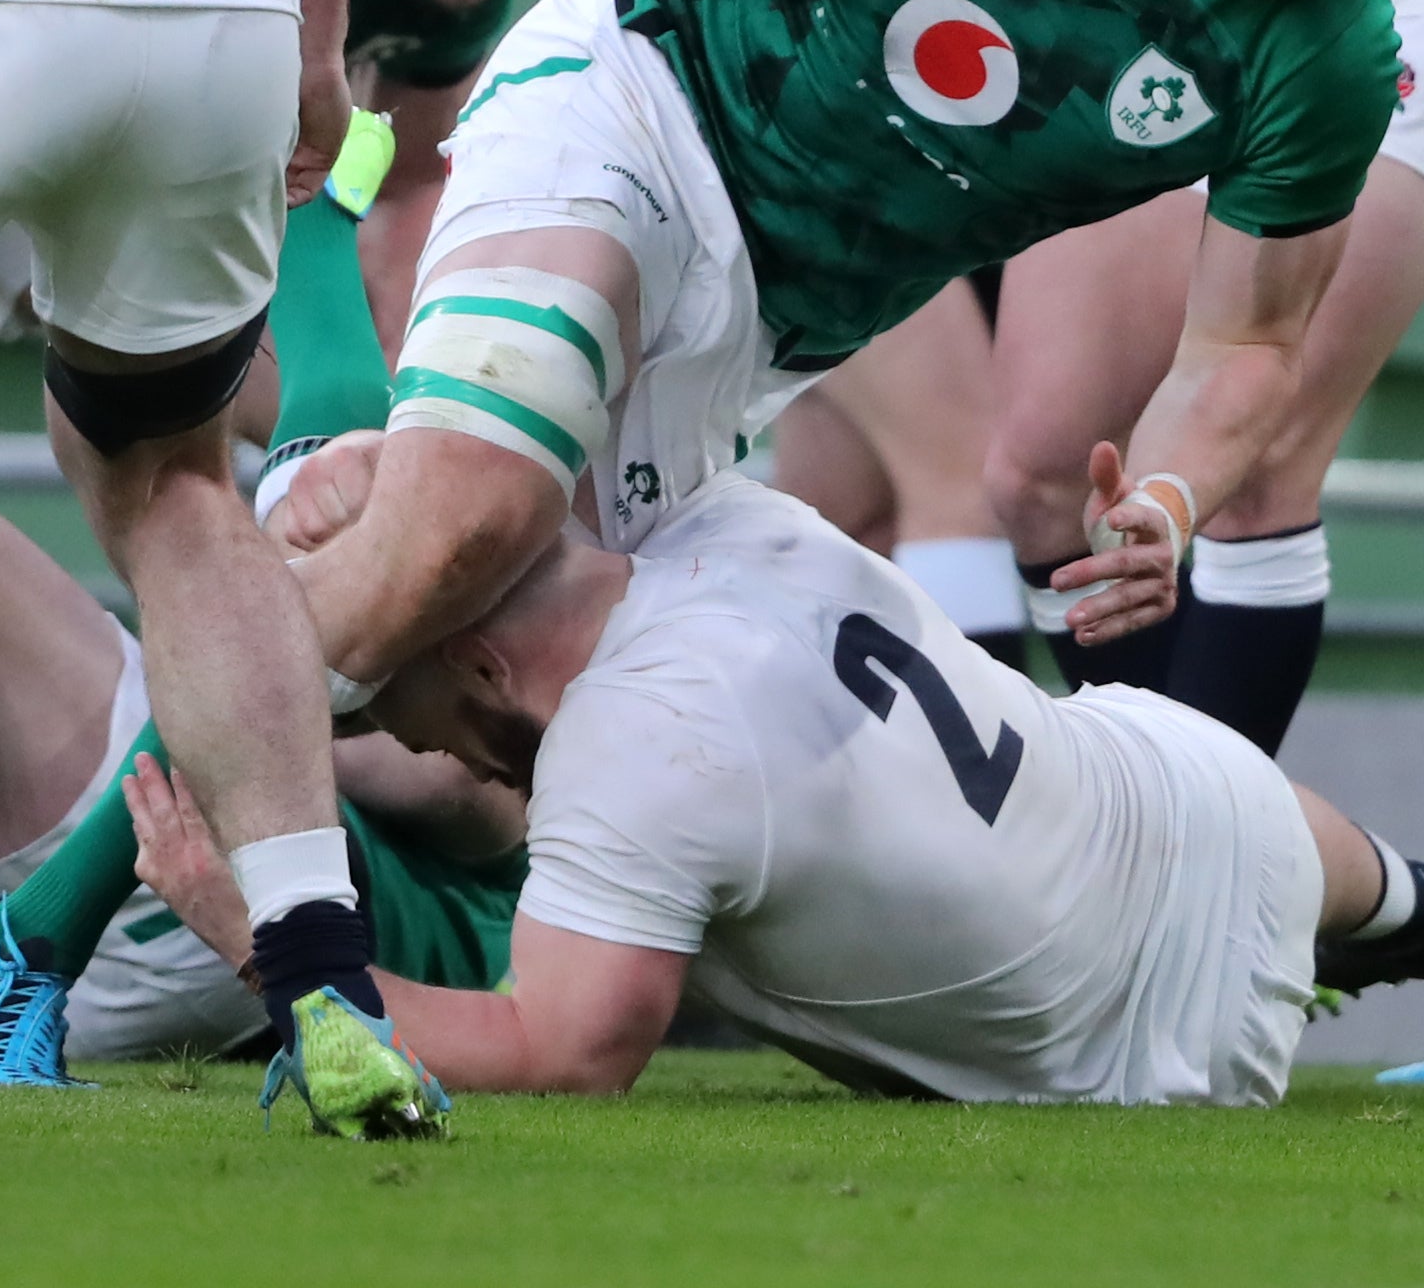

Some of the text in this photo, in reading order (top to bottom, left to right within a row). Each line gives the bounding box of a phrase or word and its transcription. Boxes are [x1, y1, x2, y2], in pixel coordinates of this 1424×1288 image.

[1117, 106, 1152, 140] IRFU
[603, 163, 669, 223] canterbury
[833, 613, 1024, 828] 2
